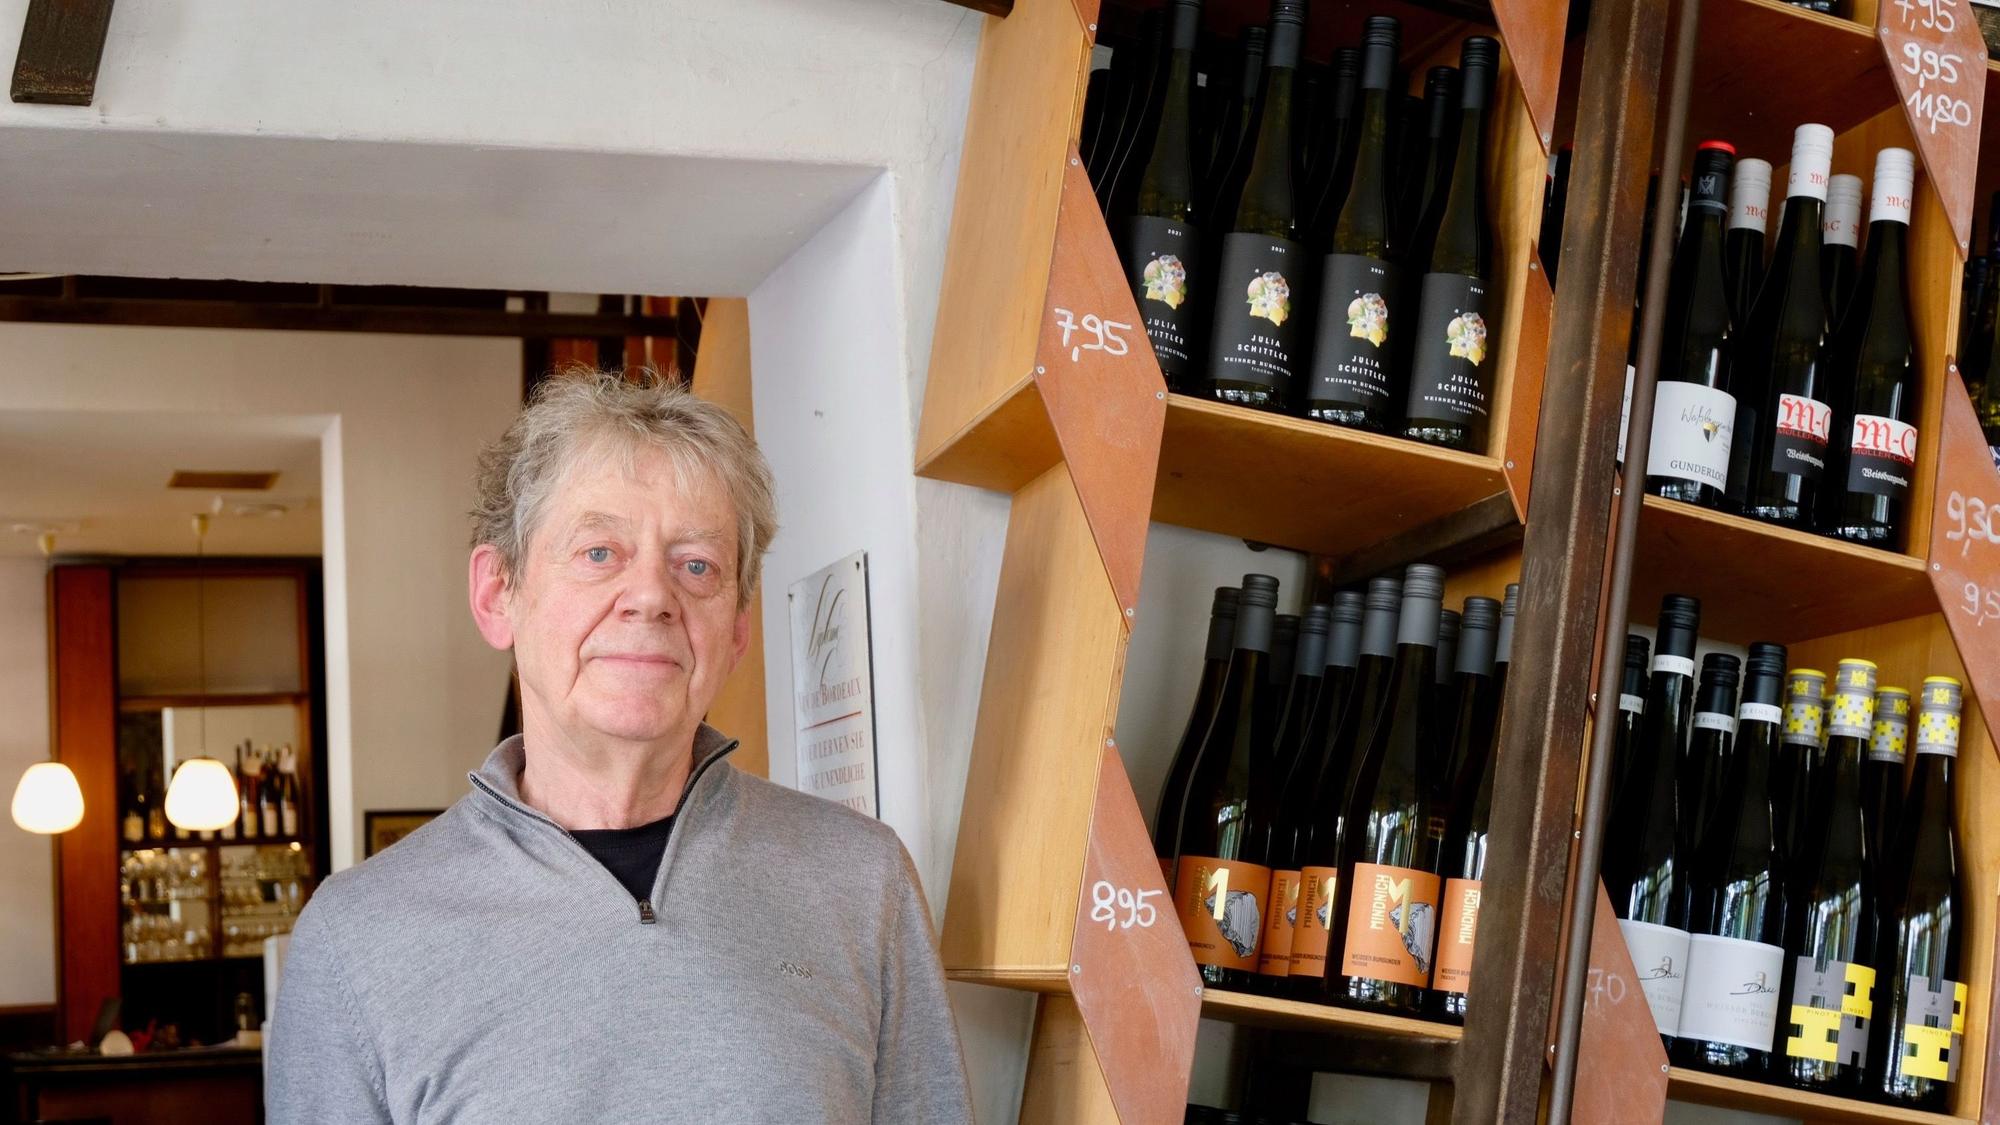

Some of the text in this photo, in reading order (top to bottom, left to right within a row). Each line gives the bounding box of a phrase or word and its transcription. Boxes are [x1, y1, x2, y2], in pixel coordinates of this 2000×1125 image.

[1901, 42, 1963, 88] 9,95
[1147, 317, 1177, 331] JULIA
[1054, 307, 1133, 362] 7,95
[1251, 333, 1280, 348] JULIA
[1237, 343, 1288, 362] SCHITTLER
[1351, 354, 1380, 369] JULIA
[1338, 363, 1386, 383] SCHITTLER
[1451, 373, 1479, 388] JULIA
[1437, 382, 1485, 401] SCHITTLER
[820, 676, 862, 707] BORDEAUX
[1091, 880, 1163, 931] 8,95
[1370, 873, 1390, 931] MINDNICH
[1459, 888, 1478, 944] MINDNICH
[1806, 1008, 1830, 1017] PINOT
